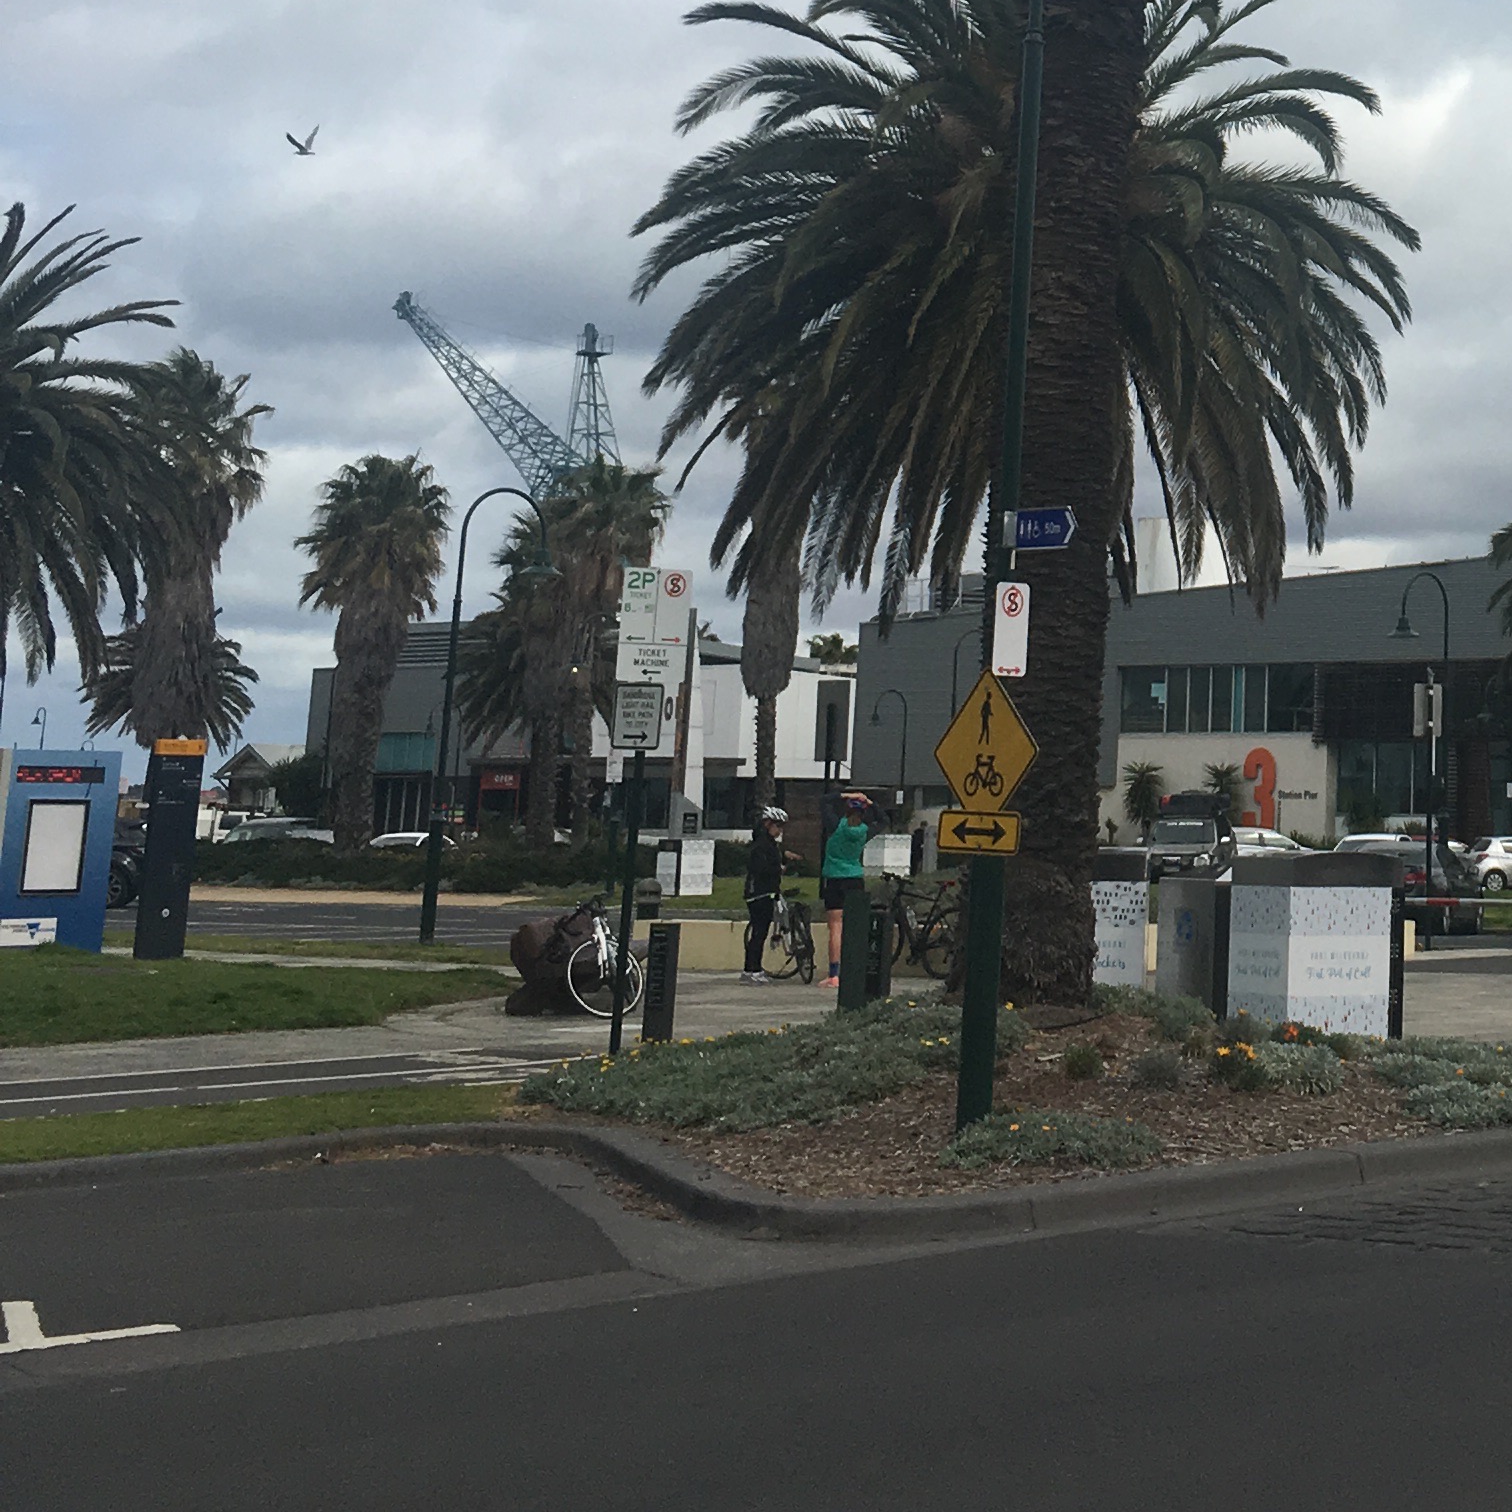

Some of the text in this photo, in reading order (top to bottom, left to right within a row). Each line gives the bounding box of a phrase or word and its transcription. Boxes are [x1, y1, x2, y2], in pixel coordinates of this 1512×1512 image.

[1045, 522, 1061, 534] 50m
[627, 571, 656, 589] 2P
[638, 648, 668, 657] TICKET
[632, 658, 670, 667] MACHINE
[1241, 746, 1277, 830] 3
